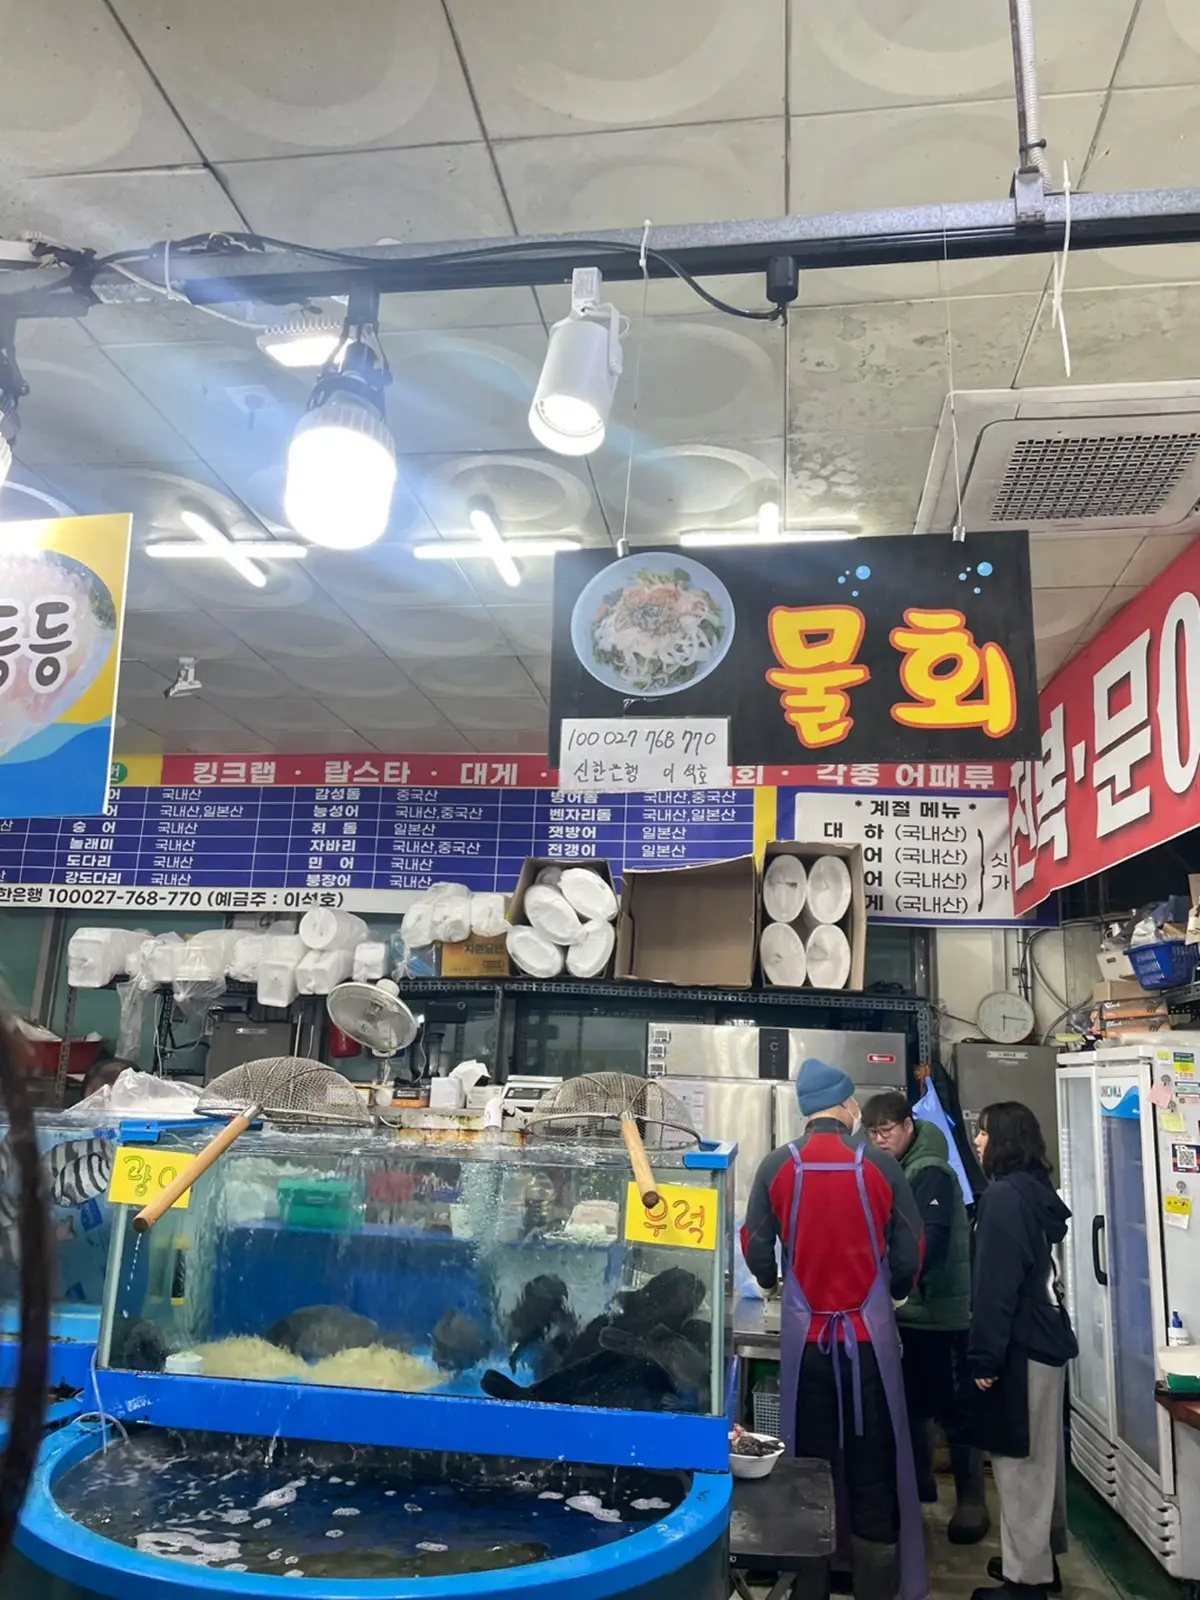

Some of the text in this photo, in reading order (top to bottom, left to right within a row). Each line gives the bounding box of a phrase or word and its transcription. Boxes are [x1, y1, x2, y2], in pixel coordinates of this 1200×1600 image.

[765, 605, 1017, 749] 물회
[568, 729, 716, 756] 100 027 768 770
[193, 760, 519, 786] 킹크랩 랍스타 대게
[573, 758, 639, 784] 신한은행
[662, 762, 675, 784] 이
[816, 763, 880, 787] 각종
[895, 763, 995, 790] 어패류
[161, 787, 203, 801] 국내산
[315, 787, 438, 802] 감성돔 중국산
[643, 790, 737, 805] 국내산,중국산
[159, 804, 245, 819] 국내산,일본산
[312, 804, 483, 821] 능성어 국내산,중국산
[549, 808, 737, 823] 벤자리돔 국내산,일본산
[870, 800, 961, 819] 계절 메뉴
[157, 821, 199, 835] 국내산
[393, 823, 437, 837] 일본산
[641, 826, 687, 840] 일본산
[894, 824, 968, 843] (국내산)
[155, 838, 197, 852] 국내산
[309, 839, 481, 855] 자바리 국내산,중국산
[547, 843, 687, 858] 전갱이 일본산
[66, 854, 194, 869] 도다리 국내산
[390, 857, 434, 872] 국내산
[894, 848, 968, 867] (국내산)
[64, 871, 192, 886] 강도다리 국내산
[305, 873, 433, 889] 붕장어 국내산
[894, 872, 968, 891] (국내산)
[48, 888, 202, 908] 100027-768-770
[207, 890, 266, 909] (예금주
[284, 891, 344, 909] 이석호)
[895, 896, 969, 915] (국내산)
